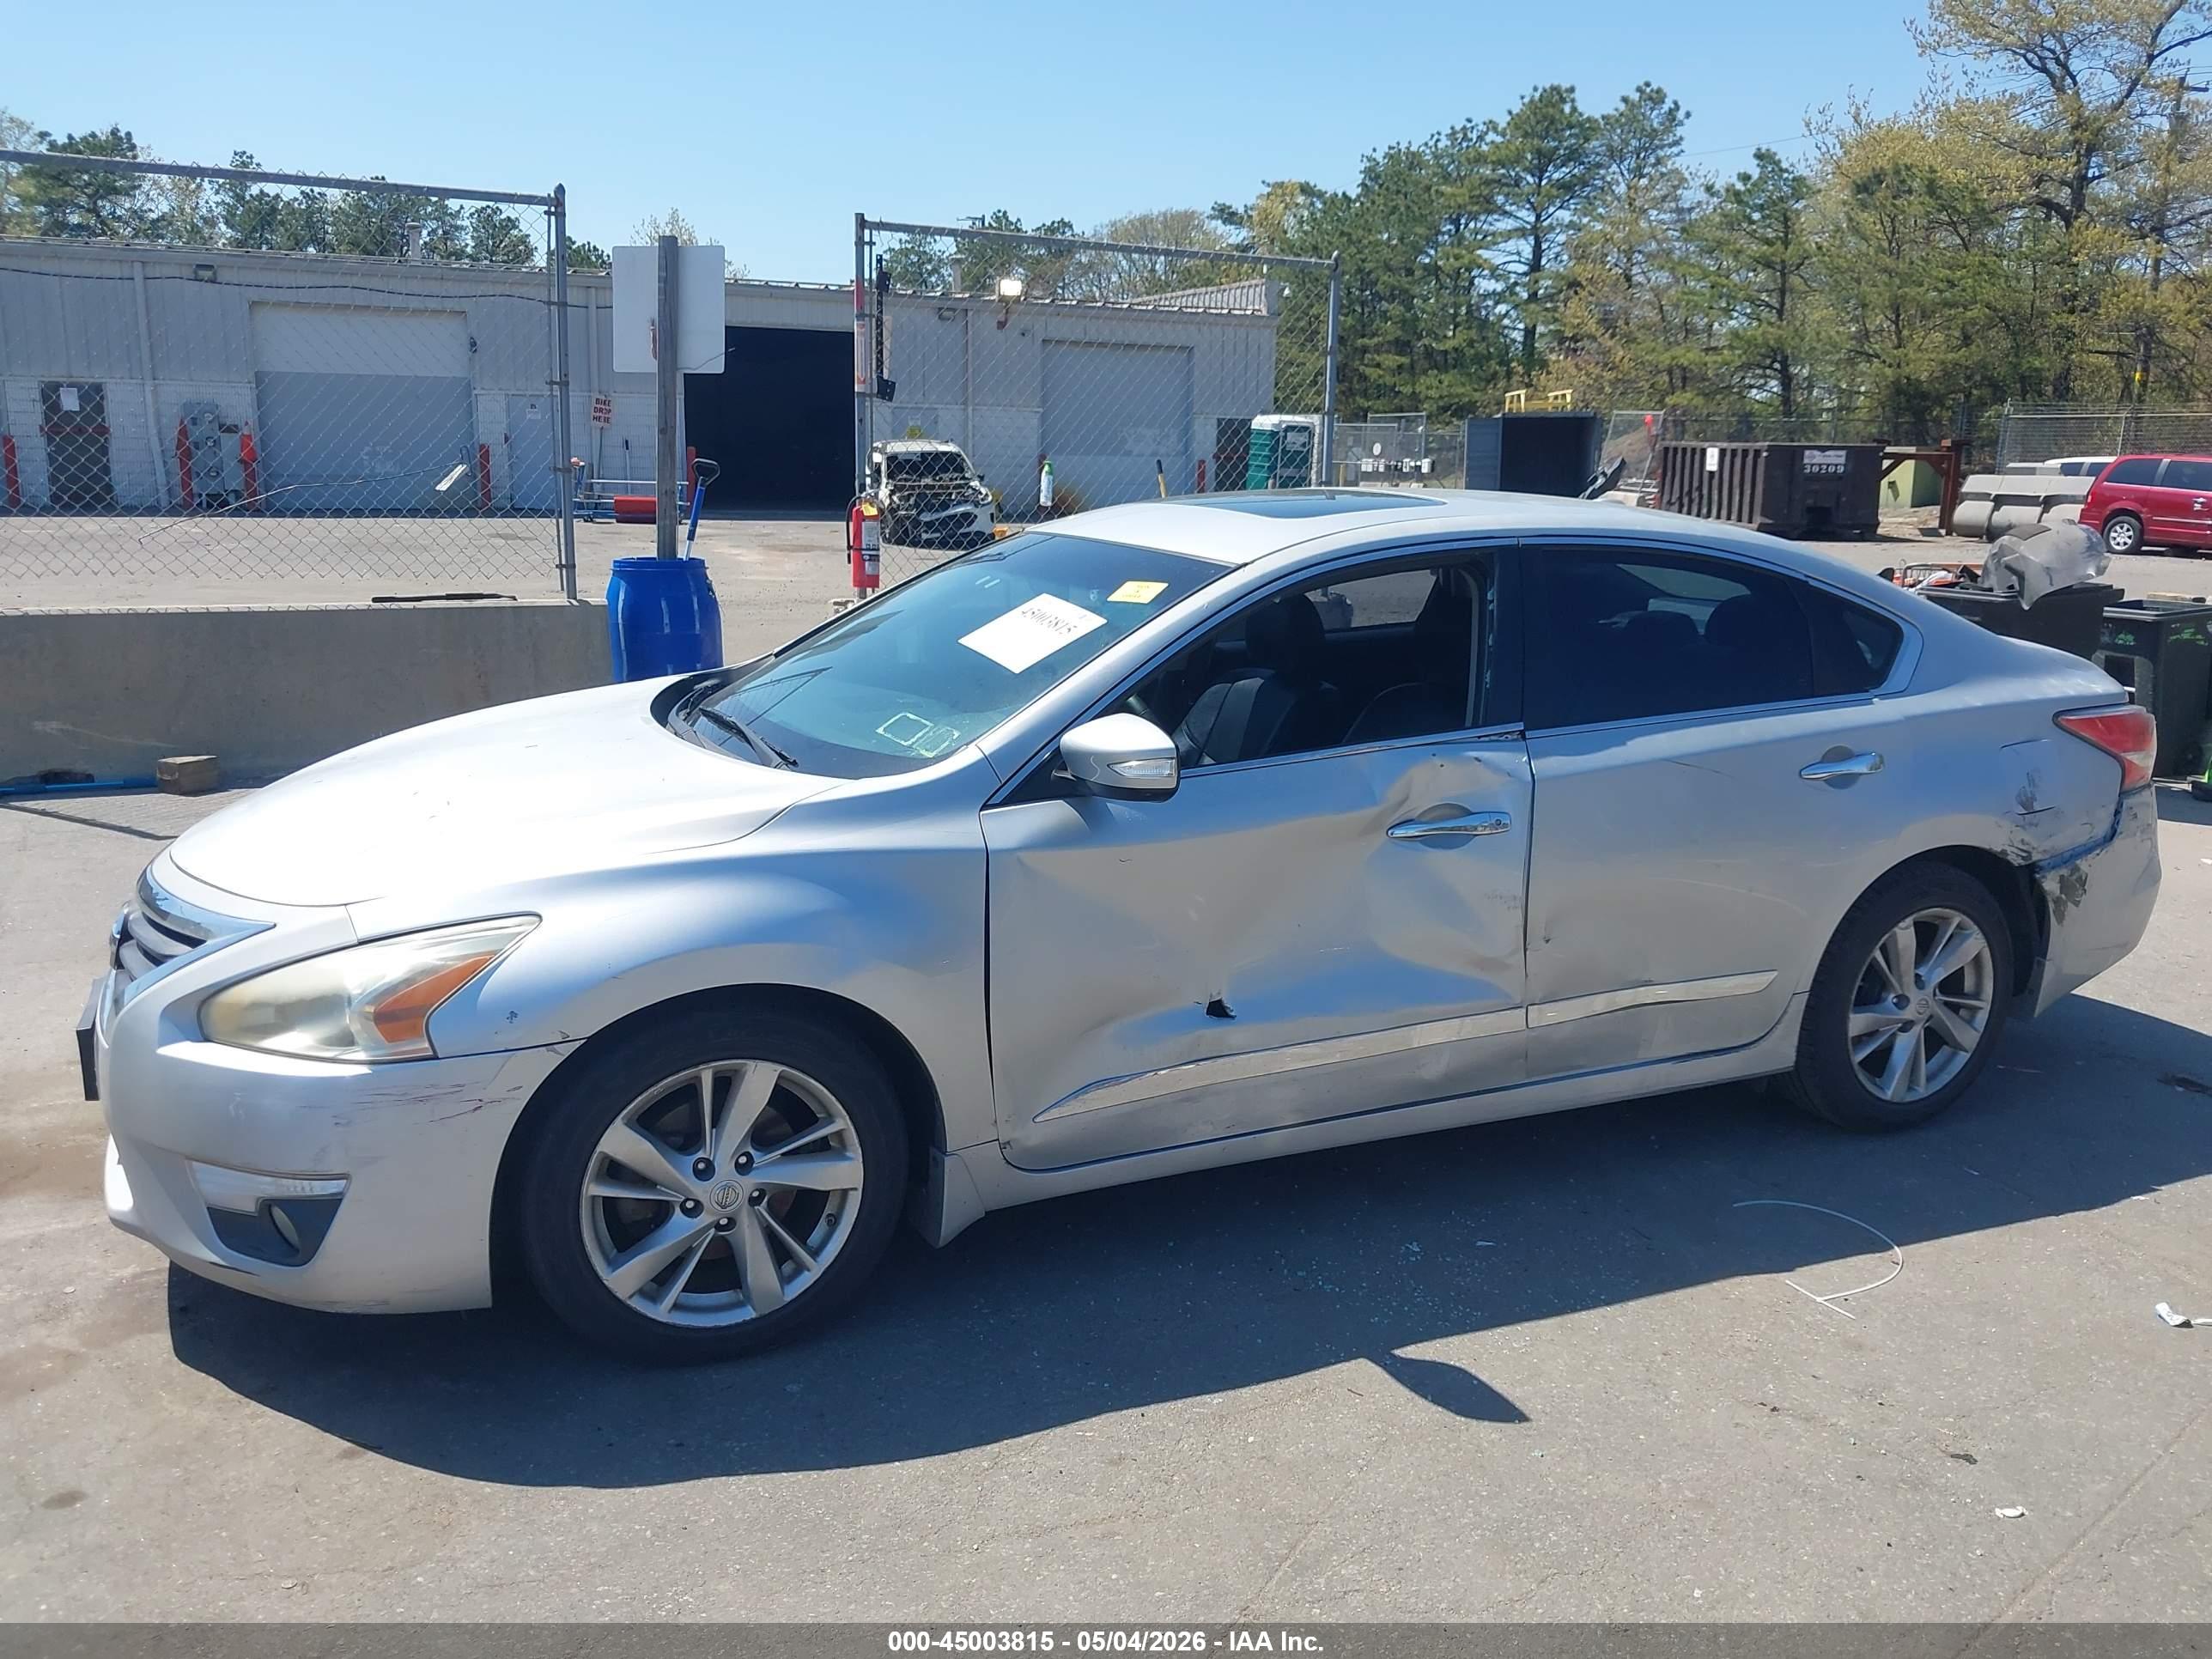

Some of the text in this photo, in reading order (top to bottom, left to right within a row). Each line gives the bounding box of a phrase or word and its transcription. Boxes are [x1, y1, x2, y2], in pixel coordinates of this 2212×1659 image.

[595, 398, 611, 407] BIKE
[593, 406, 611, 416] DROP
[592, 415, 611, 424] HERE
[1803, 464, 1845, 474] 30209
